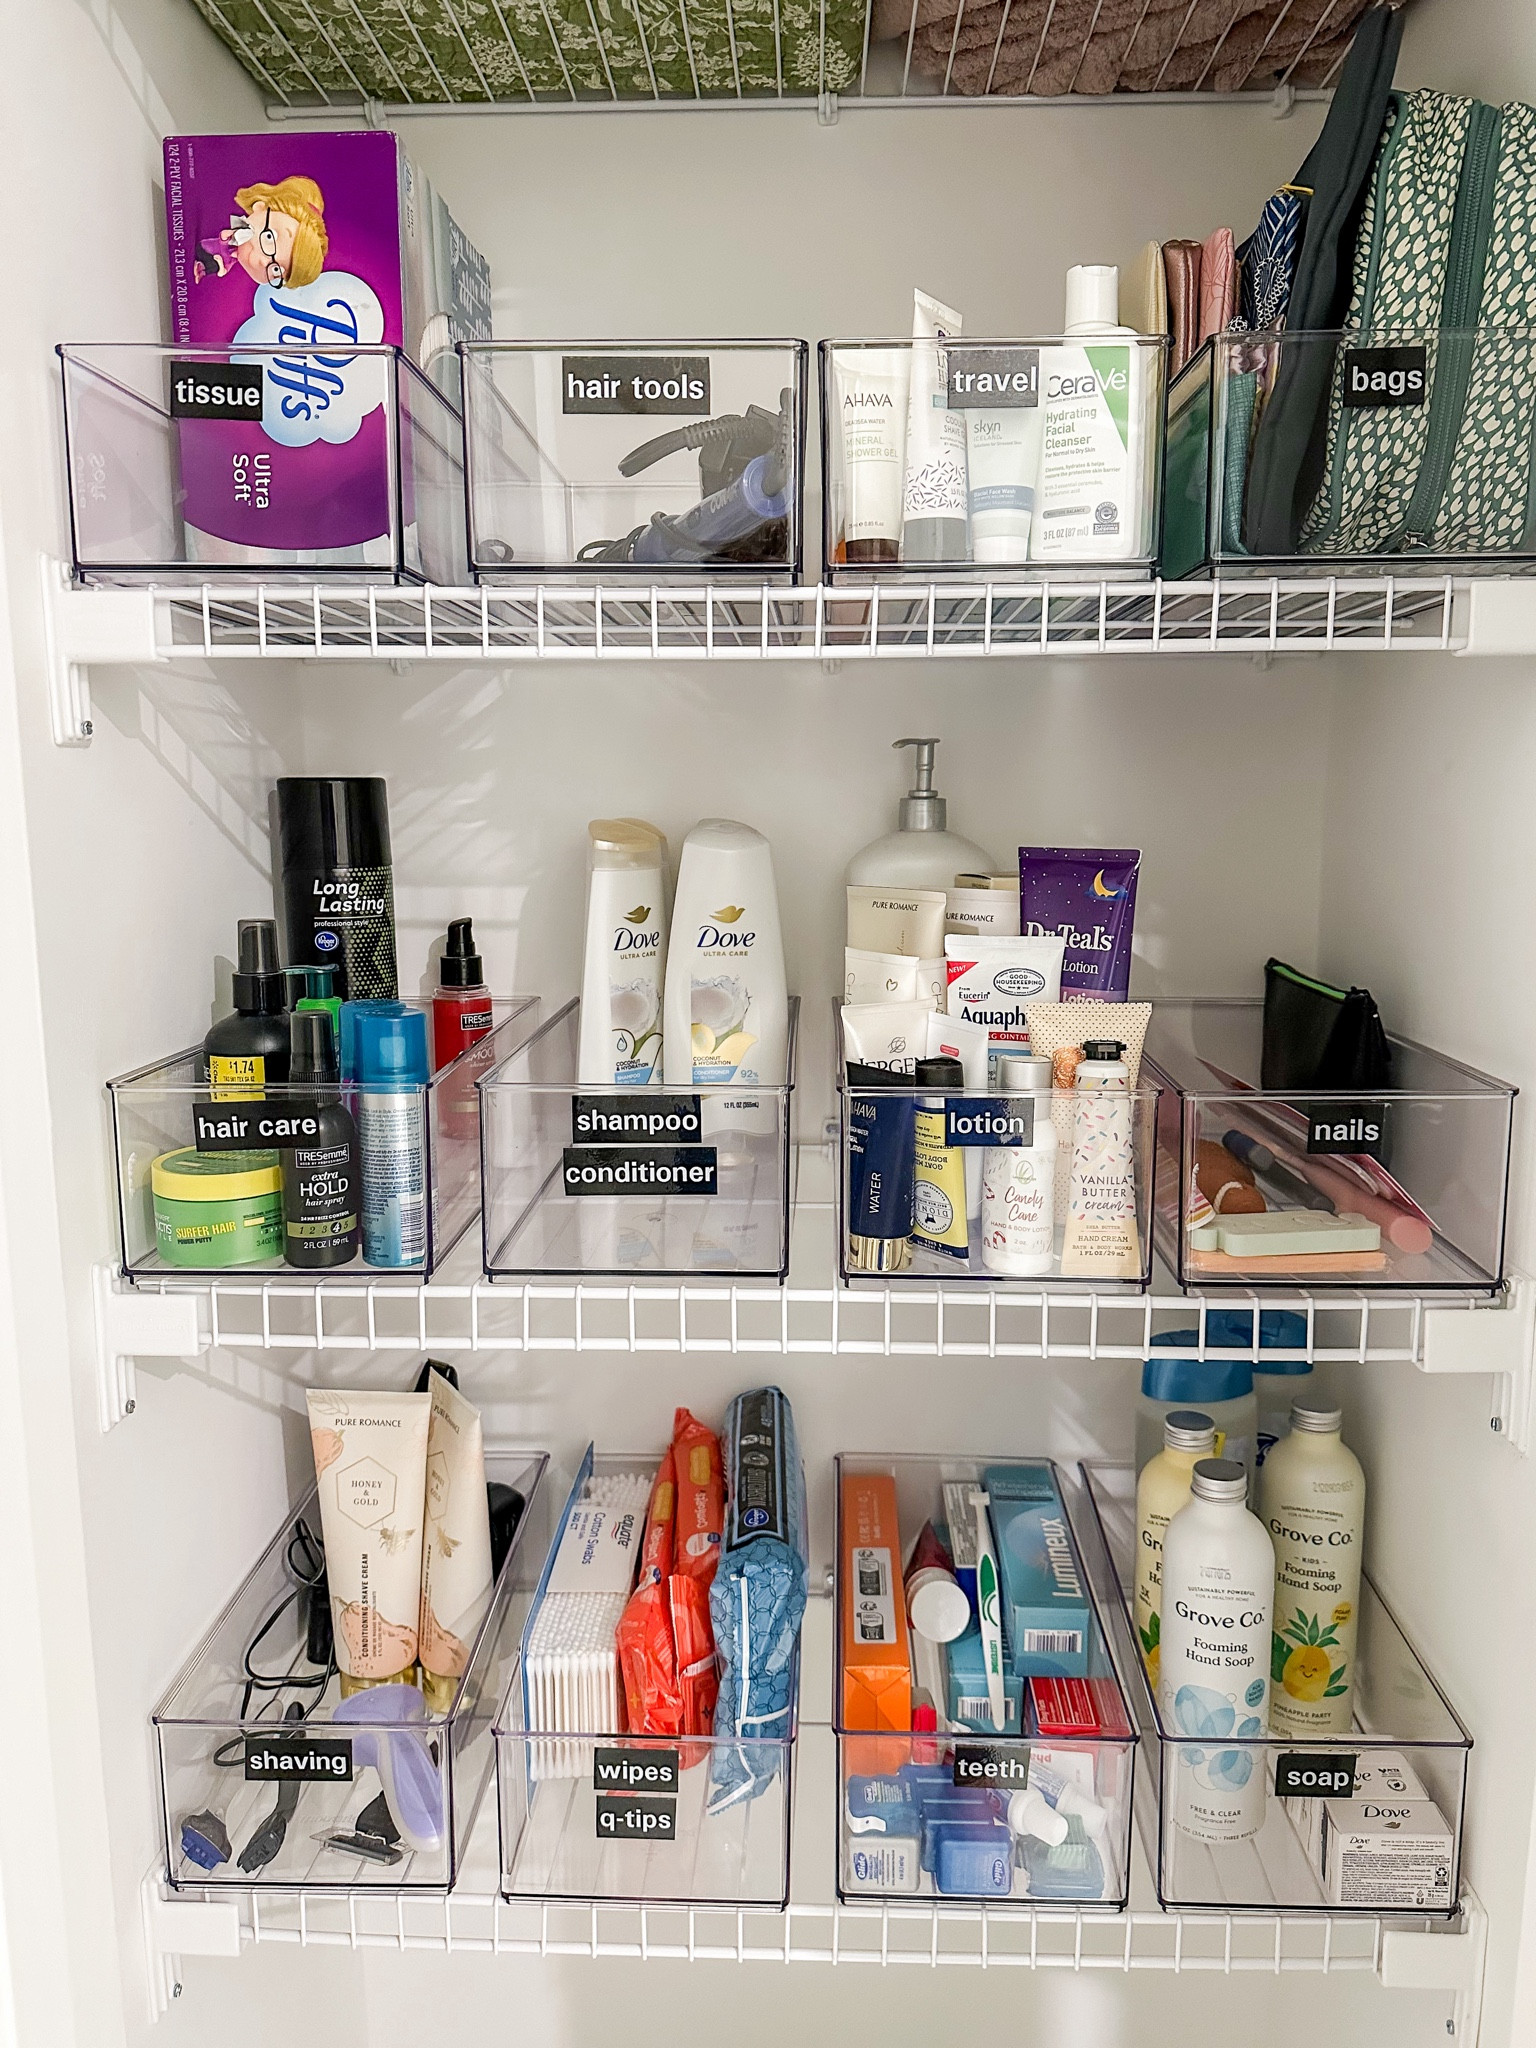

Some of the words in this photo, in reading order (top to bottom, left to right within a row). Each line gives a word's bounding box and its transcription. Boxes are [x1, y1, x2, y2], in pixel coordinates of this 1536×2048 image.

[168, 144, 179, 156] 124
[169, 158, 181, 179] 2-PLY
[170, 181, 183, 208] FACIAL
[172, 209, 184, 241] TISSUES
[175, 265, 185, 281] cm
[178, 304, 187, 317] cm
[268, 297, 359, 421] Puffs
[568, 373, 621, 399] hair
[632, 373, 704, 399] tools
[953, 366, 1037, 393] travel
[1047, 367, 1128, 398] CeraVe
[1352, 366, 1422, 396] bags
[175, 378, 260, 407] tissue
[844, 393, 893, 409] AHAVA
[1046, 407, 1097, 424] Hydrating
[974, 419, 1001, 435] skyn
[1046, 422, 1075, 437] Facial
[1045, 436, 1092, 450] Cleanser
[884, 448, 899, 458] GEL
[233, 454, 250, 502] Soft
[253, 454, 271, 510] Ultra
[313, 879, 359, 899] Long
[319, 896, 385, 915] Lasting
[872, 901, 888, 909] PURE
[889, 902, 919, 912] ROMANCE
[314, 919, 353, 928] professional
[354, 919, 369, 928] style
[946, 912, 959, 921] URE
[960, 913, 994, 923] ROMANCE
[316, 935, 336, 948] Kroger
[614, 927, 660, 951] Dove
[697, 925, 756, 948] Dove
[1058, 924, 1114, 951] Teal's
[642, 951, 657, 959] CARE
[949, 965, 966, 974] NEW!
[1063, 960, 1099, 975] Lotion
[959, 992, 989, 1000] Eucerin
[961, 1006, 1025, 1031] Aquaph
[230, 1060, 254, 1074] $1.74
[616, 1058, 641, 1067] COCONUT
[199, 1116, 249, 1139] hair
[259, 1117, 317, 1137] care
[577, 1109, 698, 1135] shampoo
[951, 1112, 1024, 1134] lotion
[1315, 1118, 1379, 1141] nails
[298, 1146, 347, 1162] TRESemmé
[565, 1161, 715, 1184] conditioner
[923, 1161, 943, 1170] GOAT
[311, 1171, 339, 1182] extra
[1080, 1175, 1129, 1186] VANILLA
[300, 1178, 349, 1197] HOLD
[869, 1172, 883, 1214] WATER
[1082, 1188, 1127, 1198] BUTTER
[305, 1199, 323, 1207] hair
[324, 1195, 346, 1208] spray
[1005, 1185, 1044, 1209] Candy
[1085, 1200, 1124, 1211] cream
[1008, 1203, 1039, 1222] Cane
[176, 1226, 210, 1239] SURFER
[212, 1221, 236, 1235] HAIR
[299, 1226, 304, 1234] 1
[309, 1226, 316, 1234] 2
[332, 1222, 340, 1233] 4
[344, 1221, 349, 1229] 5
[991, 1221, 1006, 1229] HAND
[316, 1241, 327, 1249] OZ
[335, 1418, 357, 1427] PURE
[359, 1418, 401, 1428] ROMANCE
[351, 1480, 383, 1489] HONEY
[363, 1489, 370, 1497] &
[353, 1498, 379, 1506] GOLD
[589, 1512, 606, 1537] Cotton
[618, 1514, 634, 1547] equate
[1270, 1519, 1323, 1546] Grove
[1328, 1531, 1353, 1546] Co.
[582, 1539, 599, 1565] Swabs
[1040, 1518, 1084, 1600] Lumineux
[1302, 1557, 1320, 1565] KIDS
[361, 1553, 369, 1579] CREAM
[1285, 1562, 1336, 1580] Foaming
[1188, 1586, 1225, 1594] SUSTAINABLY
[1227, 1589, 1256, 1597] POWERFUL
[1277, 1572, 1309, 1590] Hand
[1313, 1582, 1342, 1593] Soap
[361, 1581, 369, 1604] SHAVE
[1175, 1601, 1235, 1628] Grove
[1240, 1611, 1265, 1628] Co.
[361, 1606, 369, 1658] CONDITIONING
[1194, 1636, 1248, 1654] Foaming
[1185, 1648, 1220, 1666] Hand
[1225, 1656, 1254, 1667] Soap
[1273, 1702, 1309, 1718] PINEAPPLE
[250, 1751, 347, 1775] shaving
[958, 1759, 1025, 1779] teeth
[598, 1760, 673, 1785] wipes
[1287, 1769, 1349, 1791] soap
[1190, 1804, 1207, 1815] FREE
[1218, 1809, 1241, 1817] CLEAR
[1195, 1814, 1222, 1824] Fragrance
[1360, 1804, 1411, 1819] Dove
[600, 1809, 671, 1832] q-tips
[1349, 1836, 1370, 1844] Dove
[857, 1856, 866, 1879] Glide
